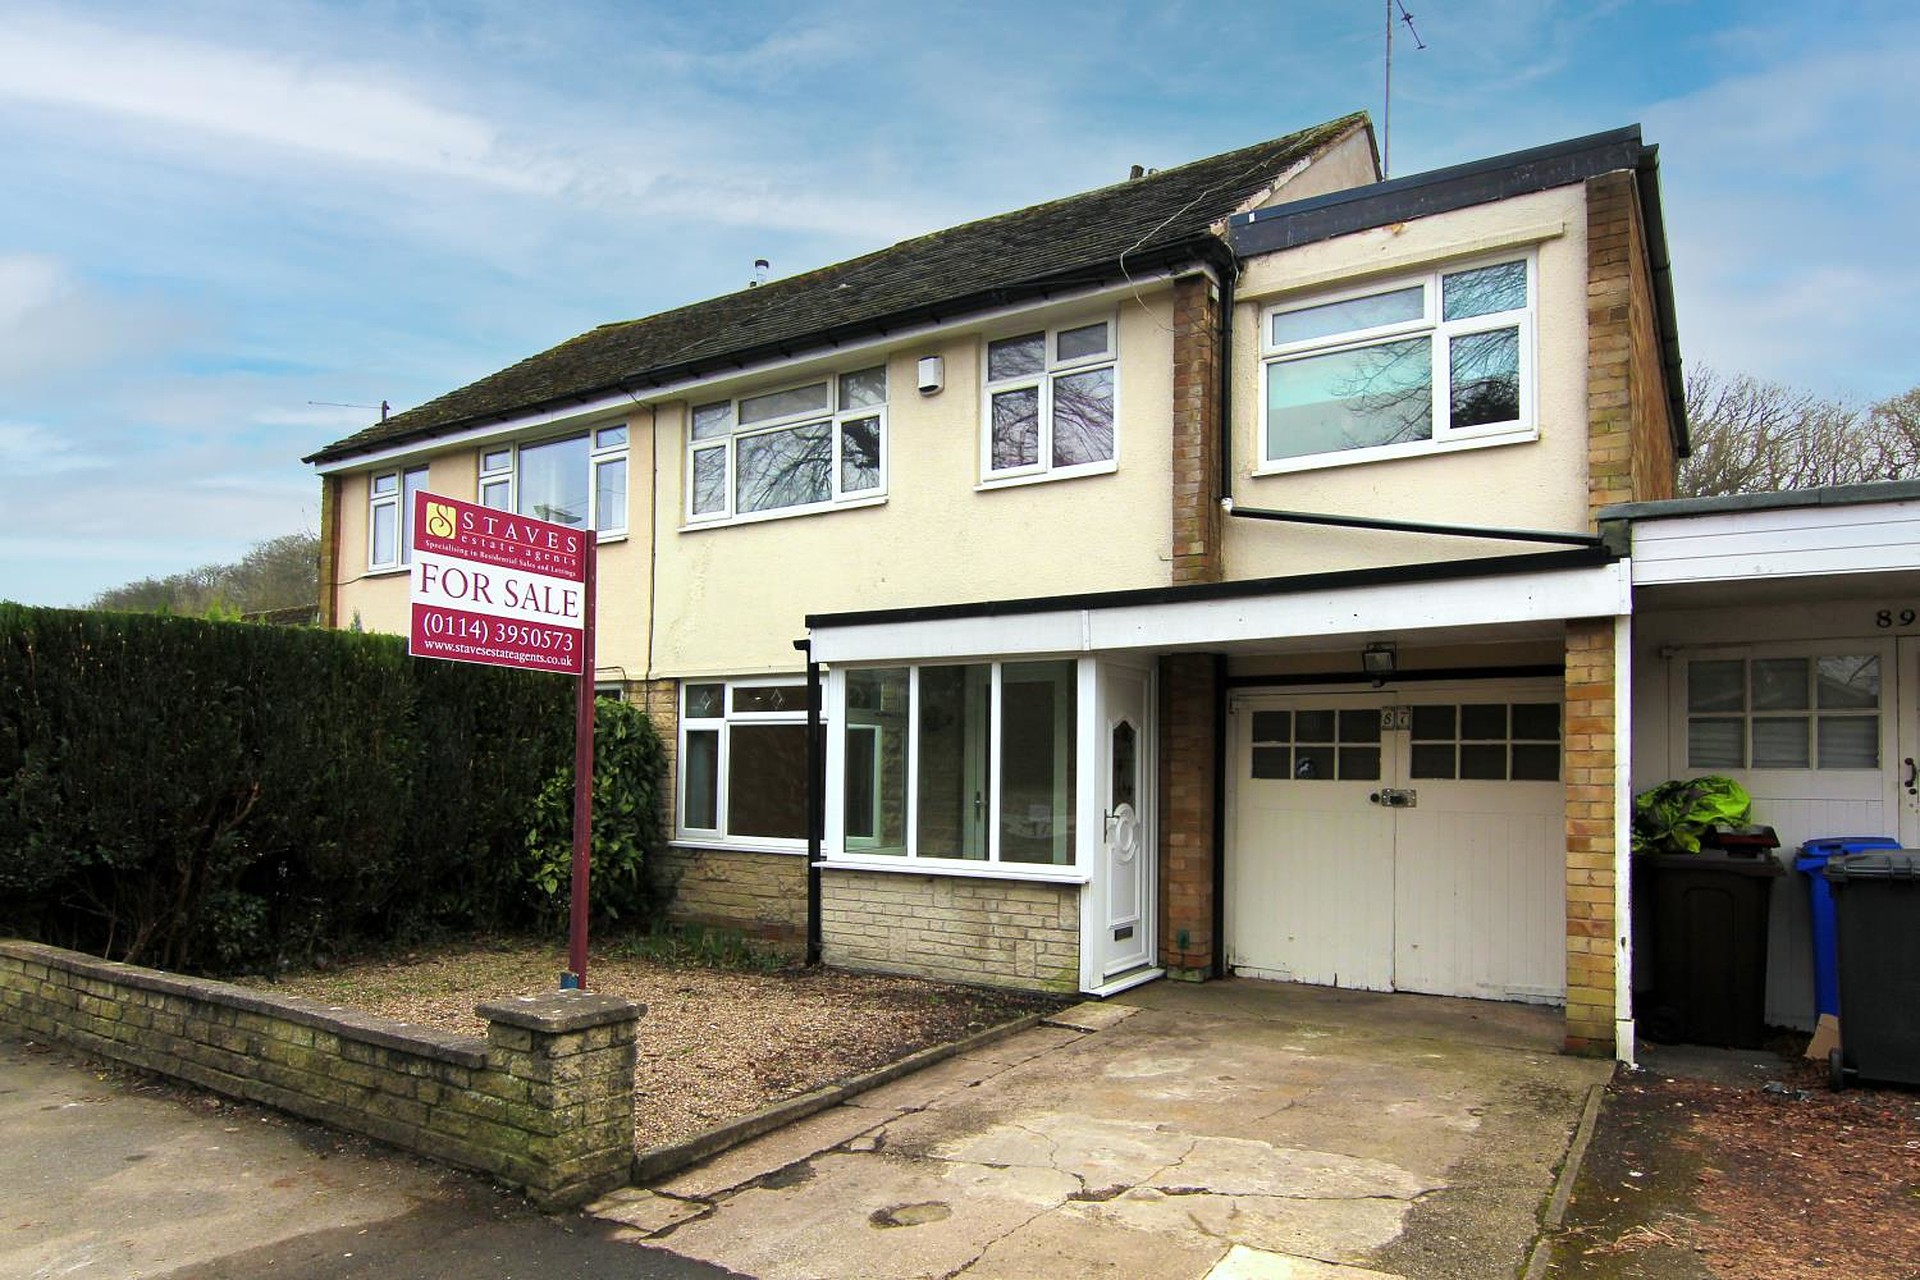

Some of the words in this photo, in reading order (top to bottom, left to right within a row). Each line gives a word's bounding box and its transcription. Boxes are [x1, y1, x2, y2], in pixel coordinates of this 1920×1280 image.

[462, 511, 577, 553] STAVES
[425, 539, 469, 557] Specialising
[470, 549, 478, 557] in
[479, 551, 518, 564] Residential
[519, 558, 536, 569] Sales
[537, 563, 549, 572] and
[461, 534, 515, 553] estate
[525, 549, 576, 567] agents
[419, 562, 494, 604] FOR
[504, 579, 579, 618] SALE
[423, 612, 489, 644] (0114)
[495, 623, 573, 651] 3950573
[1876, 609, 1916, 628] 89
[424, 639, 573, 667] www.stavesestateagents.co.uk
